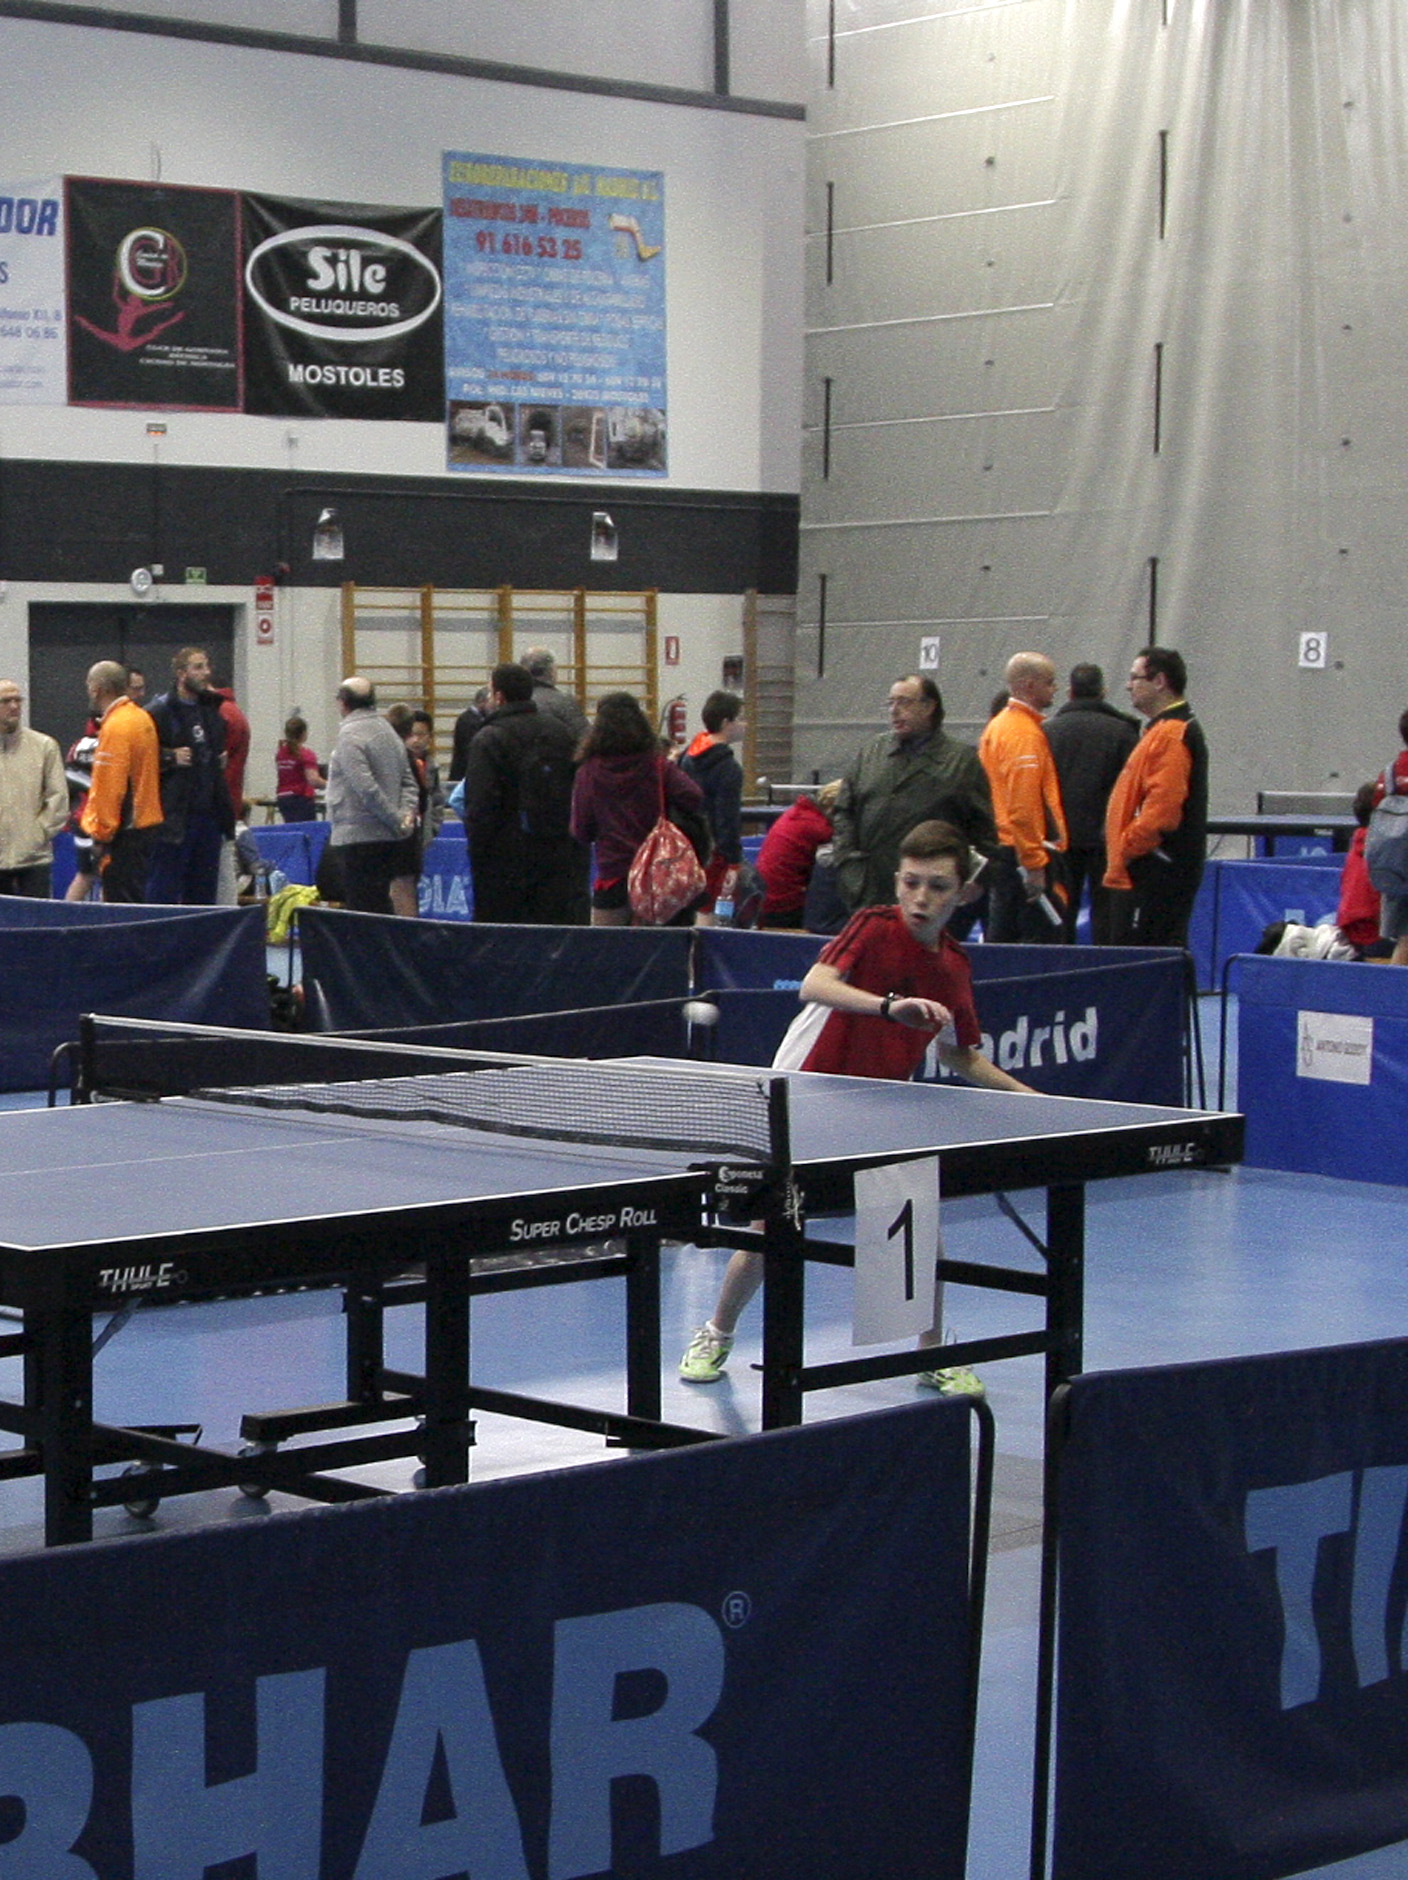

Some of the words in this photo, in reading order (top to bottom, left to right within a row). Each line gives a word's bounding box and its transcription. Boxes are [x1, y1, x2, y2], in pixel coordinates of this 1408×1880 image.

[306, 246, 387, 294] Sile
[290, 296, 401, 318] PELUQUEROS
[288, 364, 405, 388] MOSTOLES
[1304, 638, 1321, 662] 8
[1149, 1142, 1195, 1165] THULE
[715, 1183, 748, 1194] Classic
[509, 1218, 561, 1241] SUPER
[565, 1212, 617, 1235] CHESP
[619, 1206, 657, 1228] ROLL
[888, 1198, 914, 1301] 1
[100, 1262, 174, 1293] THULE
[1245, 1463, 1408, 1710] TI
